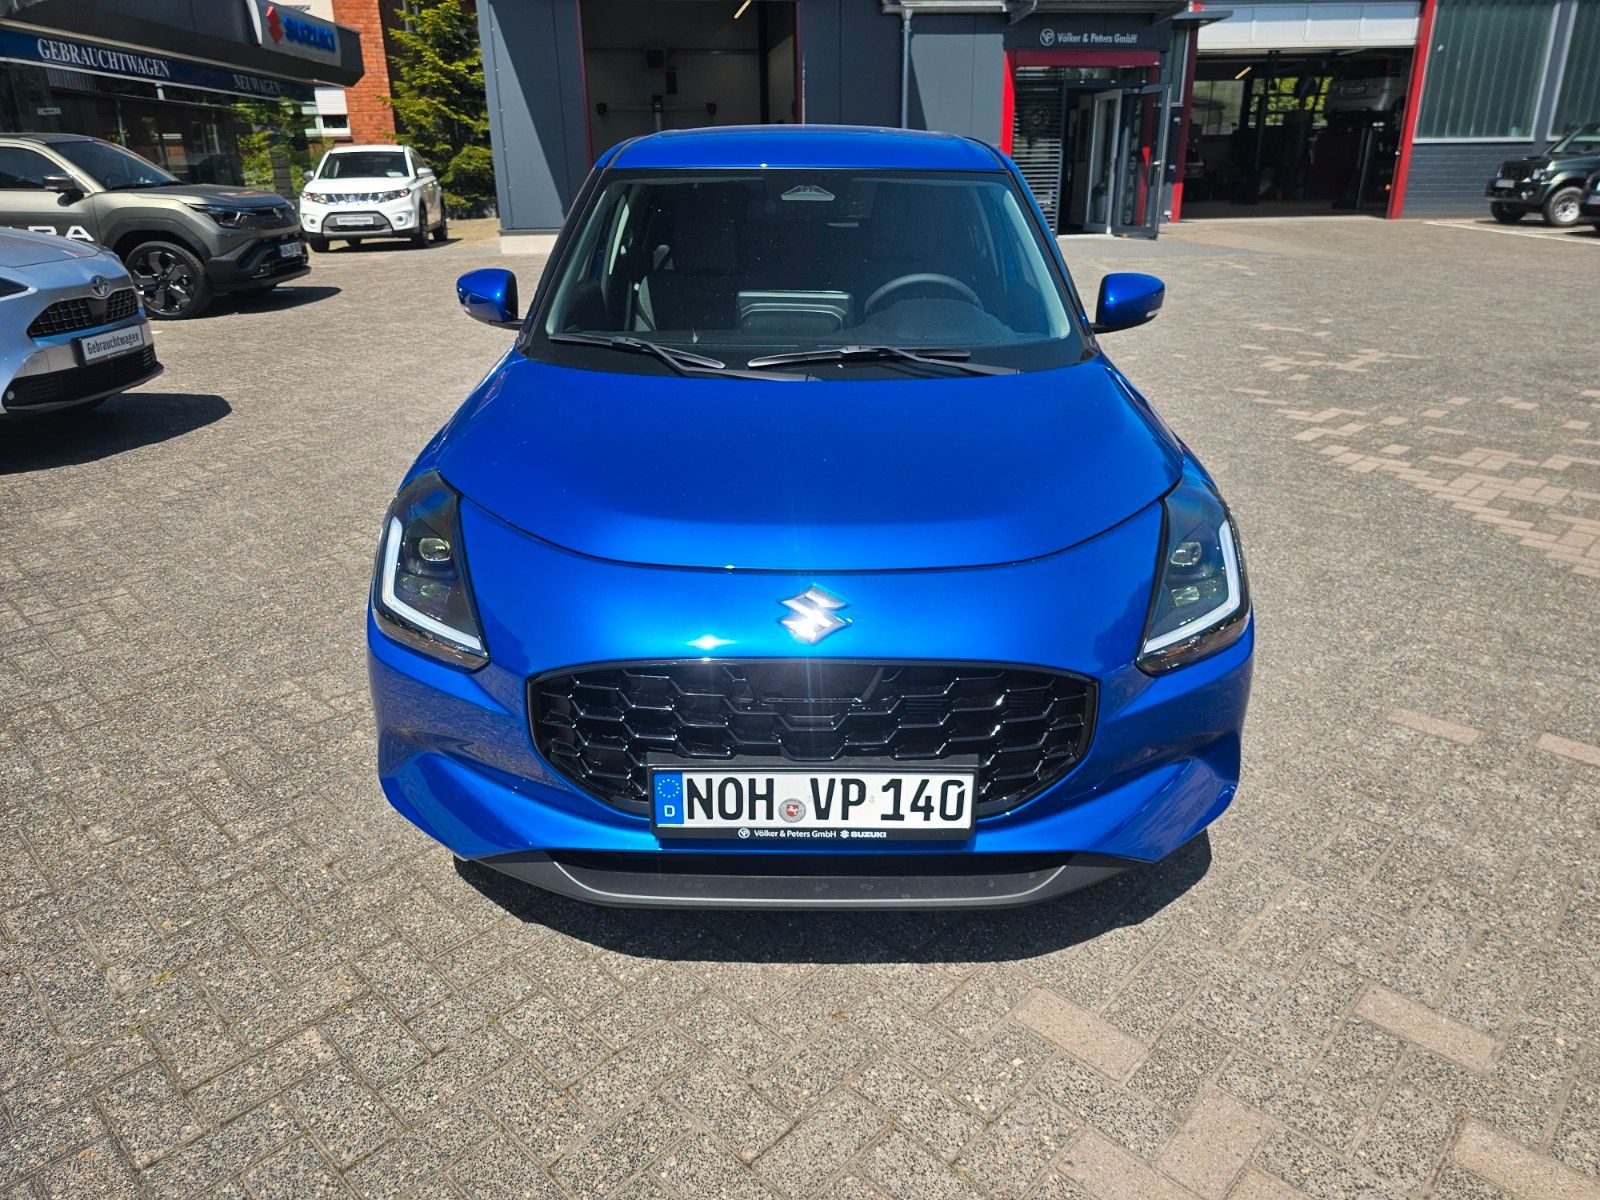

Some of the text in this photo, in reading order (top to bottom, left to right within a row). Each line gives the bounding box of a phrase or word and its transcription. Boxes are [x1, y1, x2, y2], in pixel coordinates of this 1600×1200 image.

[1057, 32, 1081, 43] Völker
[1082, 33, 1089, 42] &
[1090, 33, 1113, 43] Peters
[1114, 33, 1138, 43] GmbH
[37, 38, 170, 78] GEBRAUCHTWAGEN
[87, 332, 140, 355] Gebrauchtwagen
[686, 777, 966, 822] NOH VP 140
[664, 805, 674, 817] D
[754, 830, 778, 838] Völker
[779, 830, 786, 838] &
[787, 830, 810, 839] Peters
[811, 830, 837, 839] GmbH
[850, 831, 887, 839] SUZUKI
